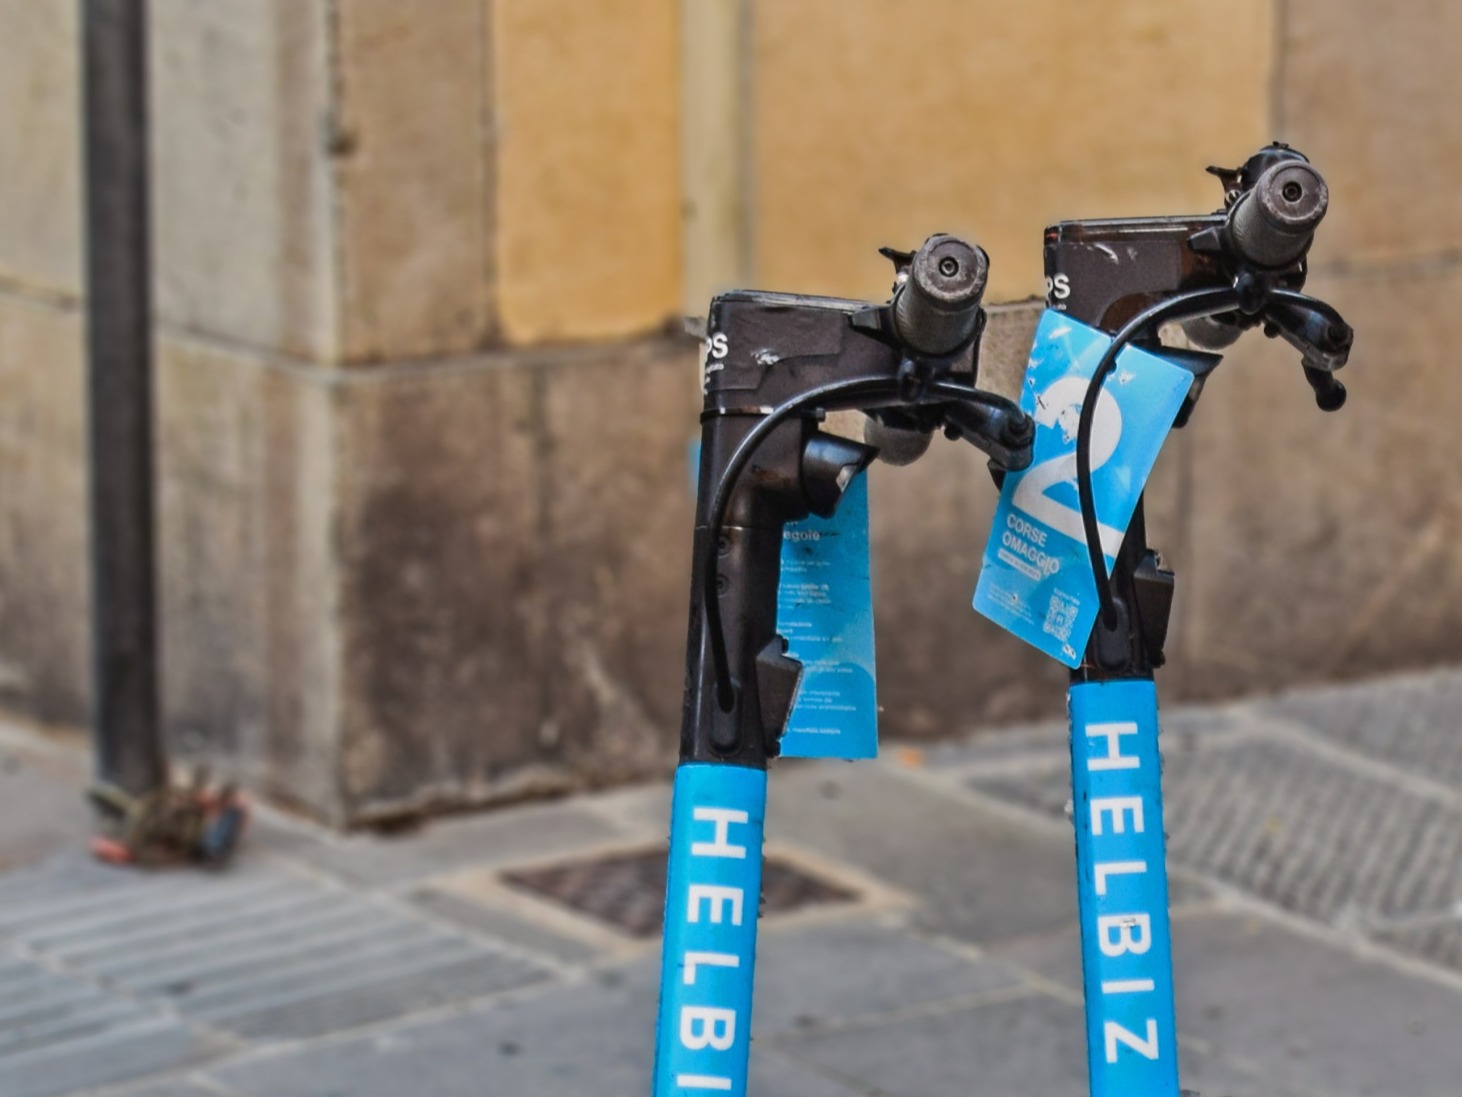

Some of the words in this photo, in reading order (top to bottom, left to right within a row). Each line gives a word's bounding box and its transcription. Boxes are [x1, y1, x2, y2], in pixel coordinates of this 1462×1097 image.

[1012, 376, 1127, 560] 2
[782, 529, 821, 543] egole
[1007, 513, 1048, 547] CORSE
[1002, 531, 1061, 577] OMAGGIO
[1084, 720, 1160, 1064] HELBIZ
